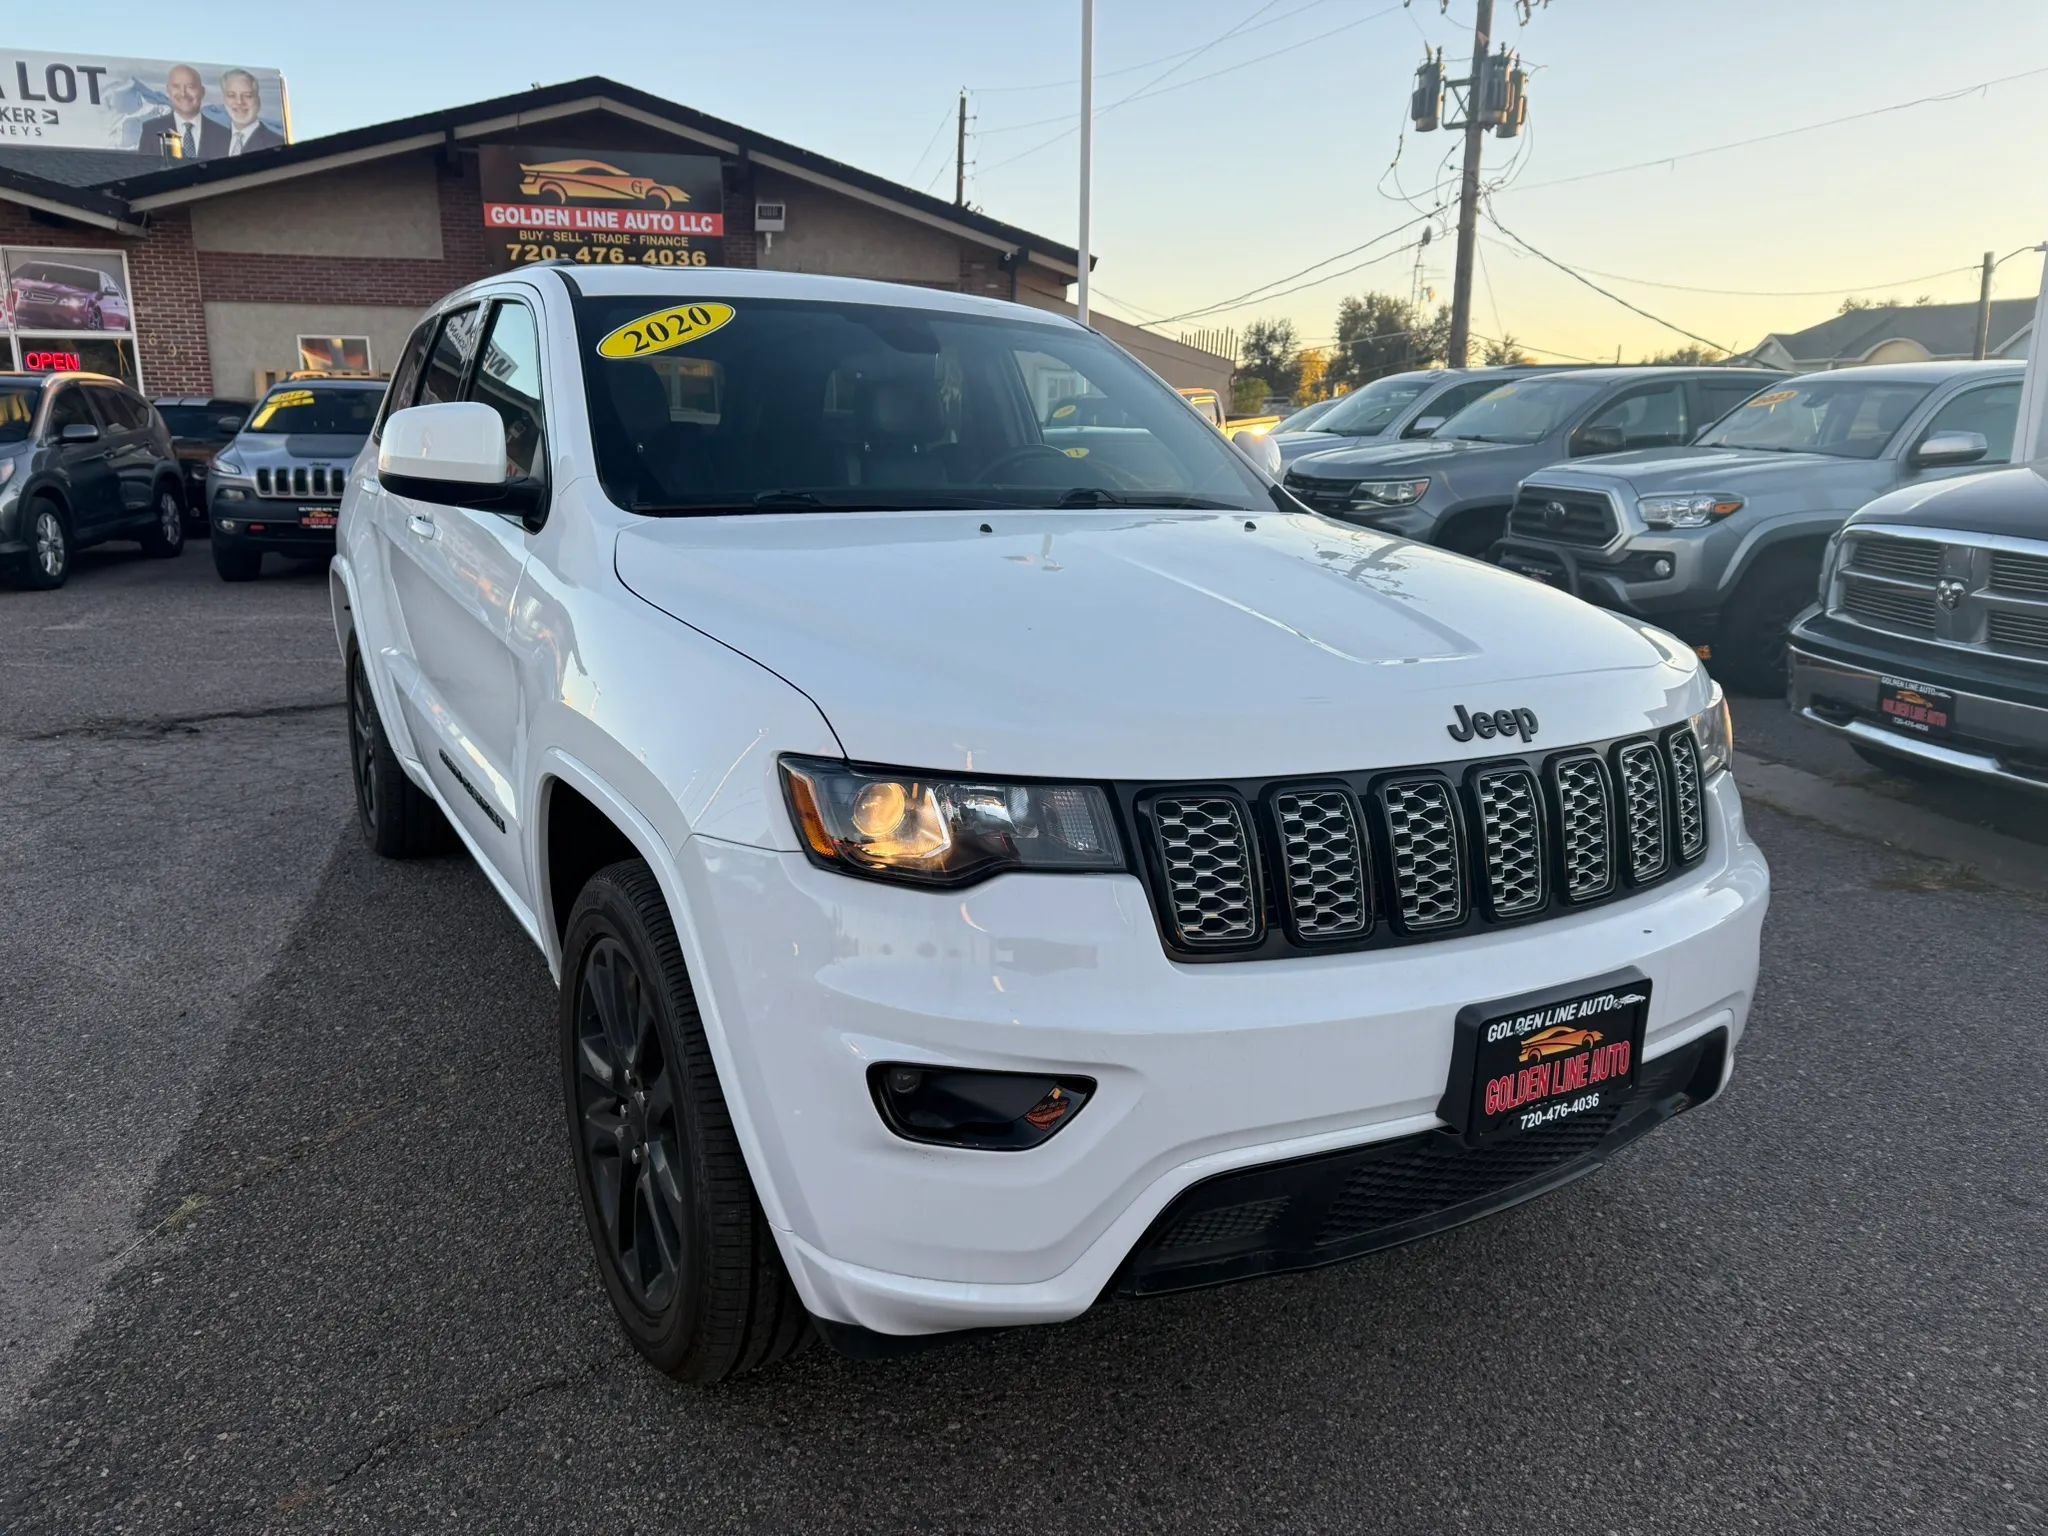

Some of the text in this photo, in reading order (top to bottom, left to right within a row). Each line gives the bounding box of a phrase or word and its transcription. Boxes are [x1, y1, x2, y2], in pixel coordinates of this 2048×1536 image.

[15, 60, 107, 105] LOT
[491, 206, 713, 233] GOLDEN LINE AUTO LLC
[519, 230, 689, 247] BUY SELL TRADE FINANCE
[506, 244, 707, 266] 720-476-4036
[623, 306, 712, 353] 2020
[25, 352, 80, 371] OPEN
[1446, 704, 1539, 743] Jeep
[1487, 994, 1615, 1043] GOLDEN LINE AUTO
[1485, 1040, 1631, 1116] GOLDEN LINE AUTO
[1520, 1093, 1600, 1131] 720-476-4036
